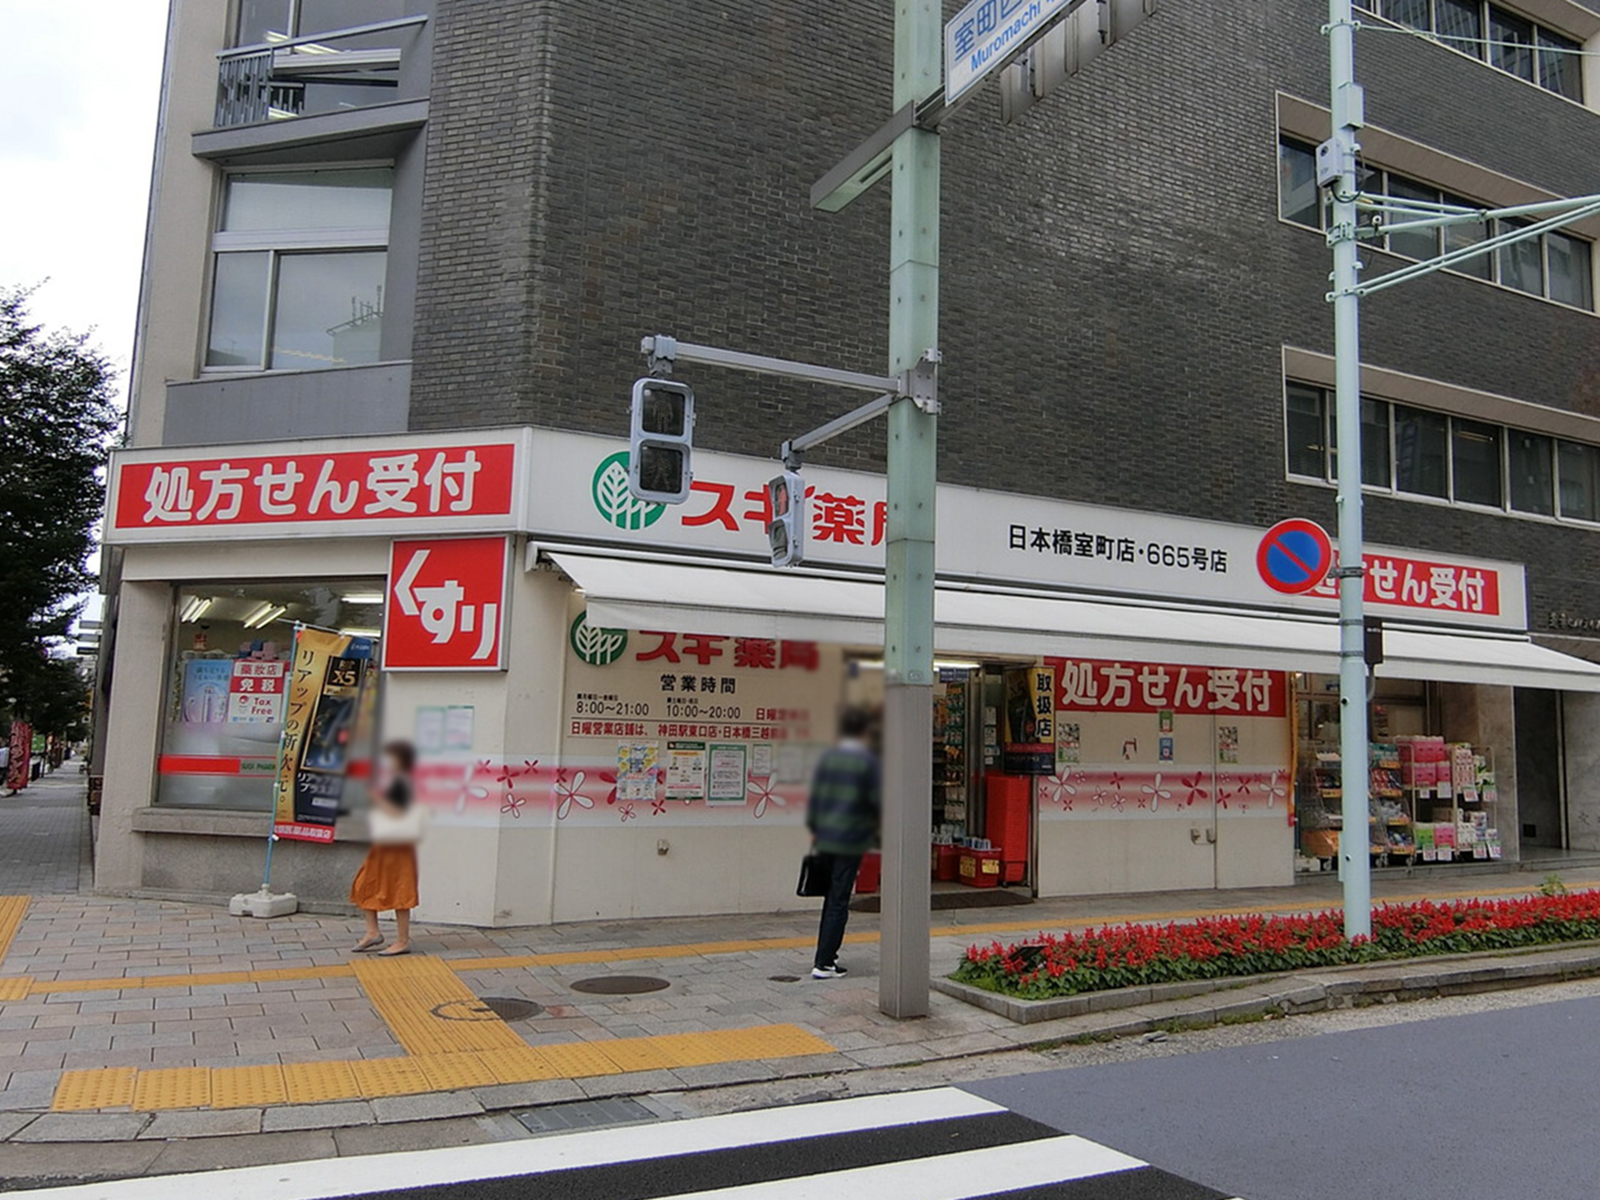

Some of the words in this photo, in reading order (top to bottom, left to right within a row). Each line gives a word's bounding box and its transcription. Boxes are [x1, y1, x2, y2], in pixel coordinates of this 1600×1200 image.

[971, 1, 1041, 72] Muromachi
[143, 450, 481, 524] 処方せん受付
[394, 549, 497, 660] くすり
[1314, 557, 1485, 612] せん受付
[240, 679, 275, 692] 免税
[254, 697, 272, 706] Tax
[332, 670, 356, 686] X5
[660, 674, 736, 694] 営業時間
[1061, 660, 1272, 712] 処方せん受付
[251, 707, 273, 715] Free
[1035, 673, 1052, 738] 取扱店
